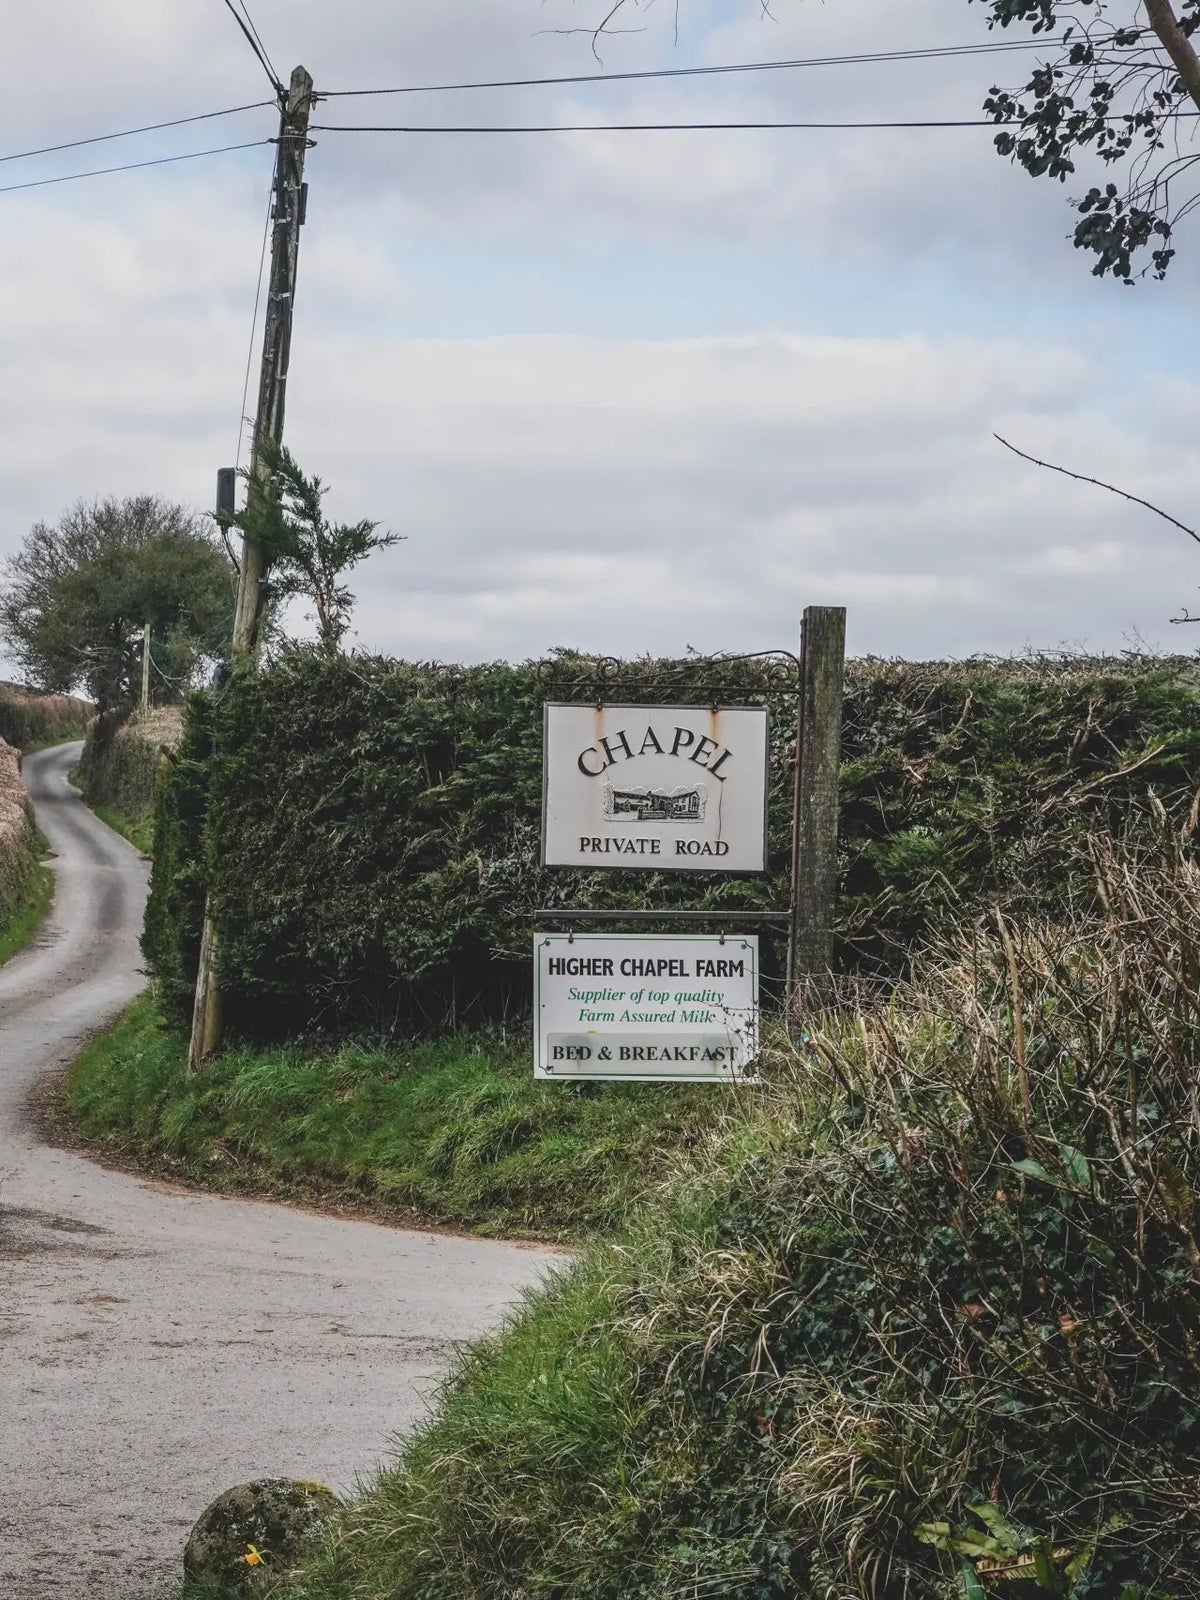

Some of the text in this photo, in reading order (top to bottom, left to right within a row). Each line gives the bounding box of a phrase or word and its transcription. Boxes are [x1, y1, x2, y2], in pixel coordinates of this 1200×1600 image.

[577, 725, 734, 782] CHAPEL
[580, 837, 729, 856] PRIVATE ROAD
[548, 957, 745, 978] HIGHER CHAPEL FARM
[568, 987, 725, 1004] Supplier of top quality
[578, 1009, 714, 1023] Farm Assured Milk
[552, 1045, 738, 1061] BED & BREAKFAST
